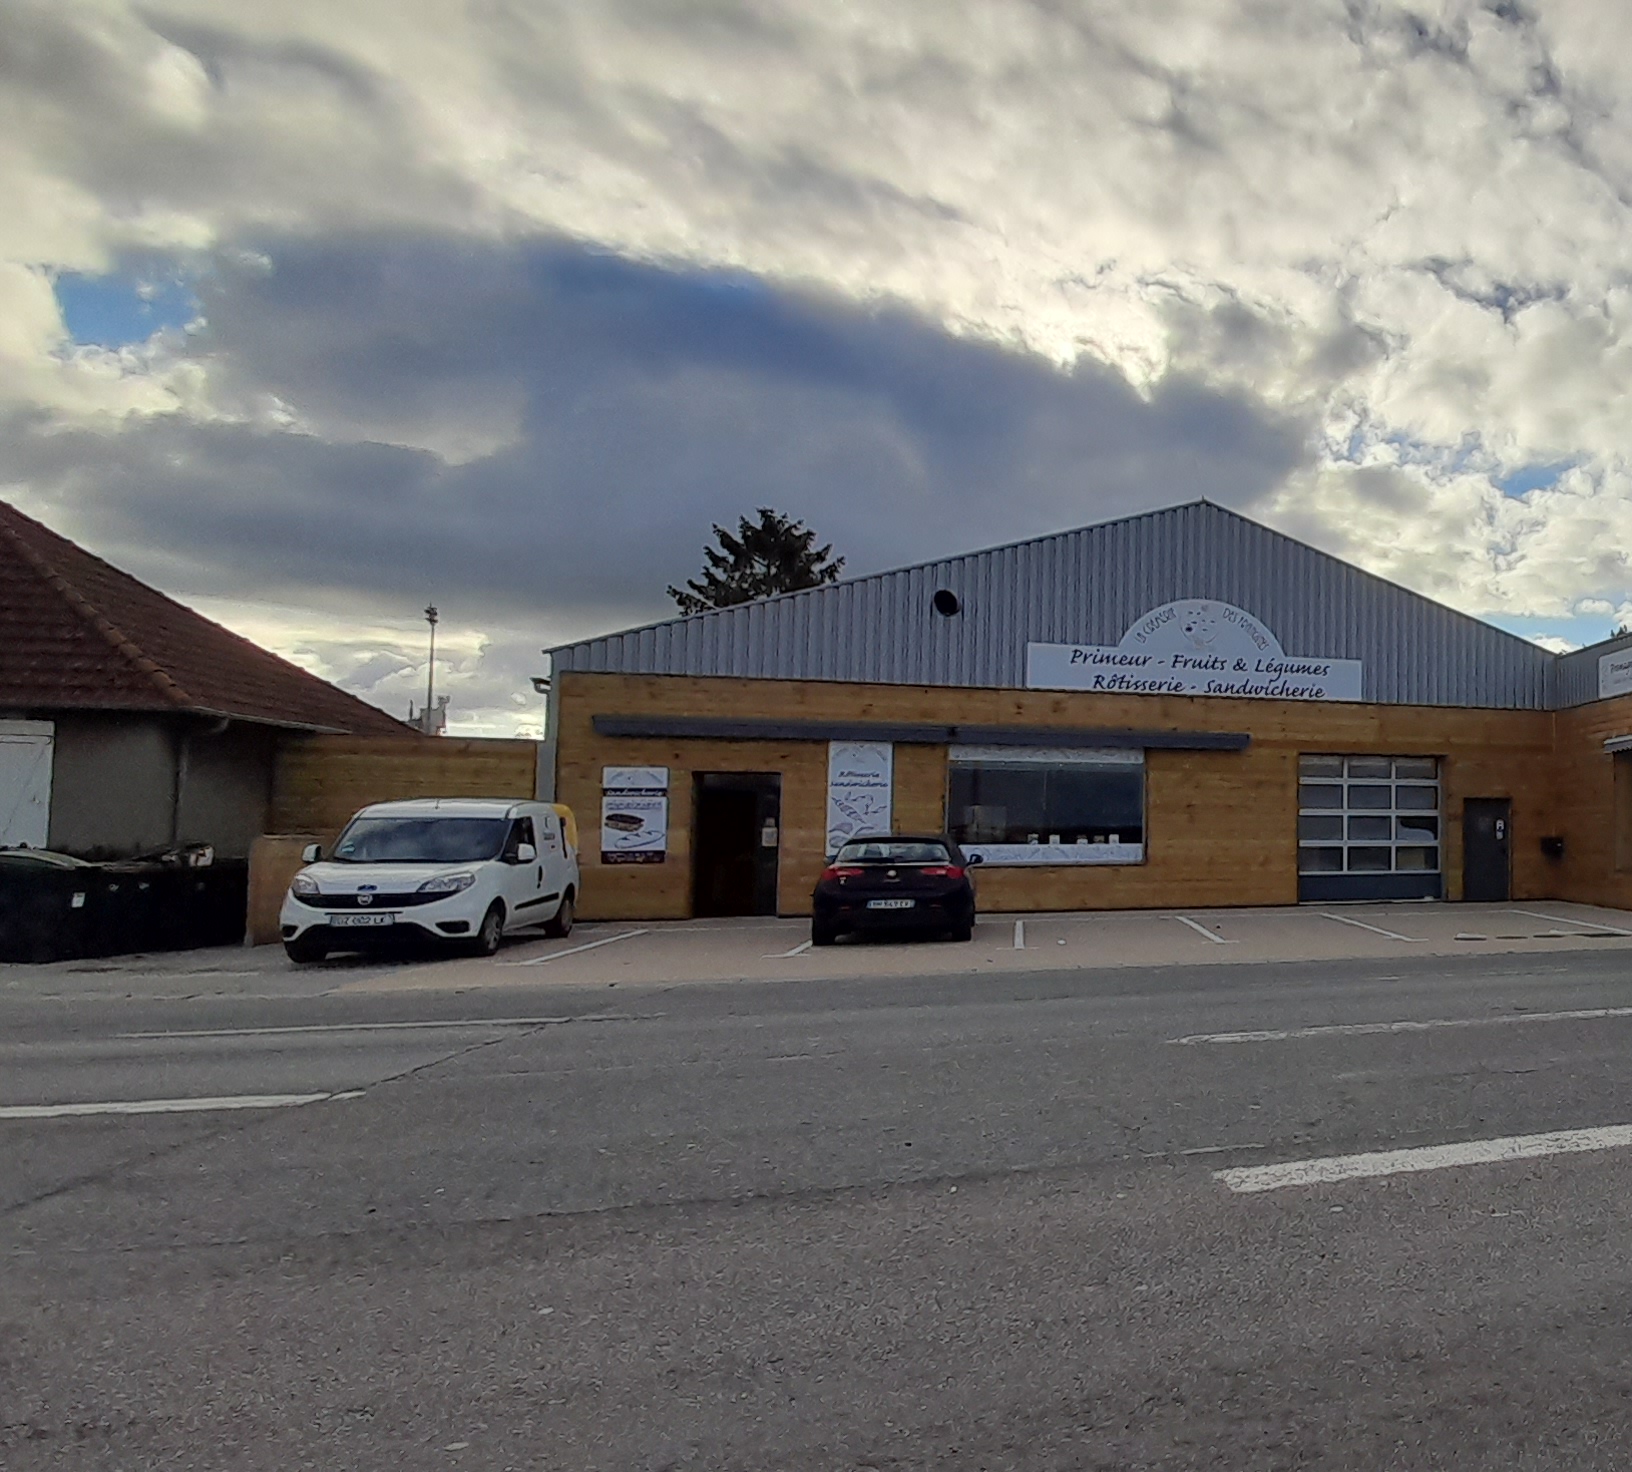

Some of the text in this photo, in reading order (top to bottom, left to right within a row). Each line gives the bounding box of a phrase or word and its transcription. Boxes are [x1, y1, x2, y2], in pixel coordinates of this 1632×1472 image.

[1070, 648, 1152, 667] Primeur
[1171, 654, 1227, 669] Fruits
[1232, 657, 1248, 671] &
[1255, 657, 1330, 681] Légumes
[1092, 673, 1185, 692] Rôtisserie
[1203, 678, 1325, 698] Sandwicherie
